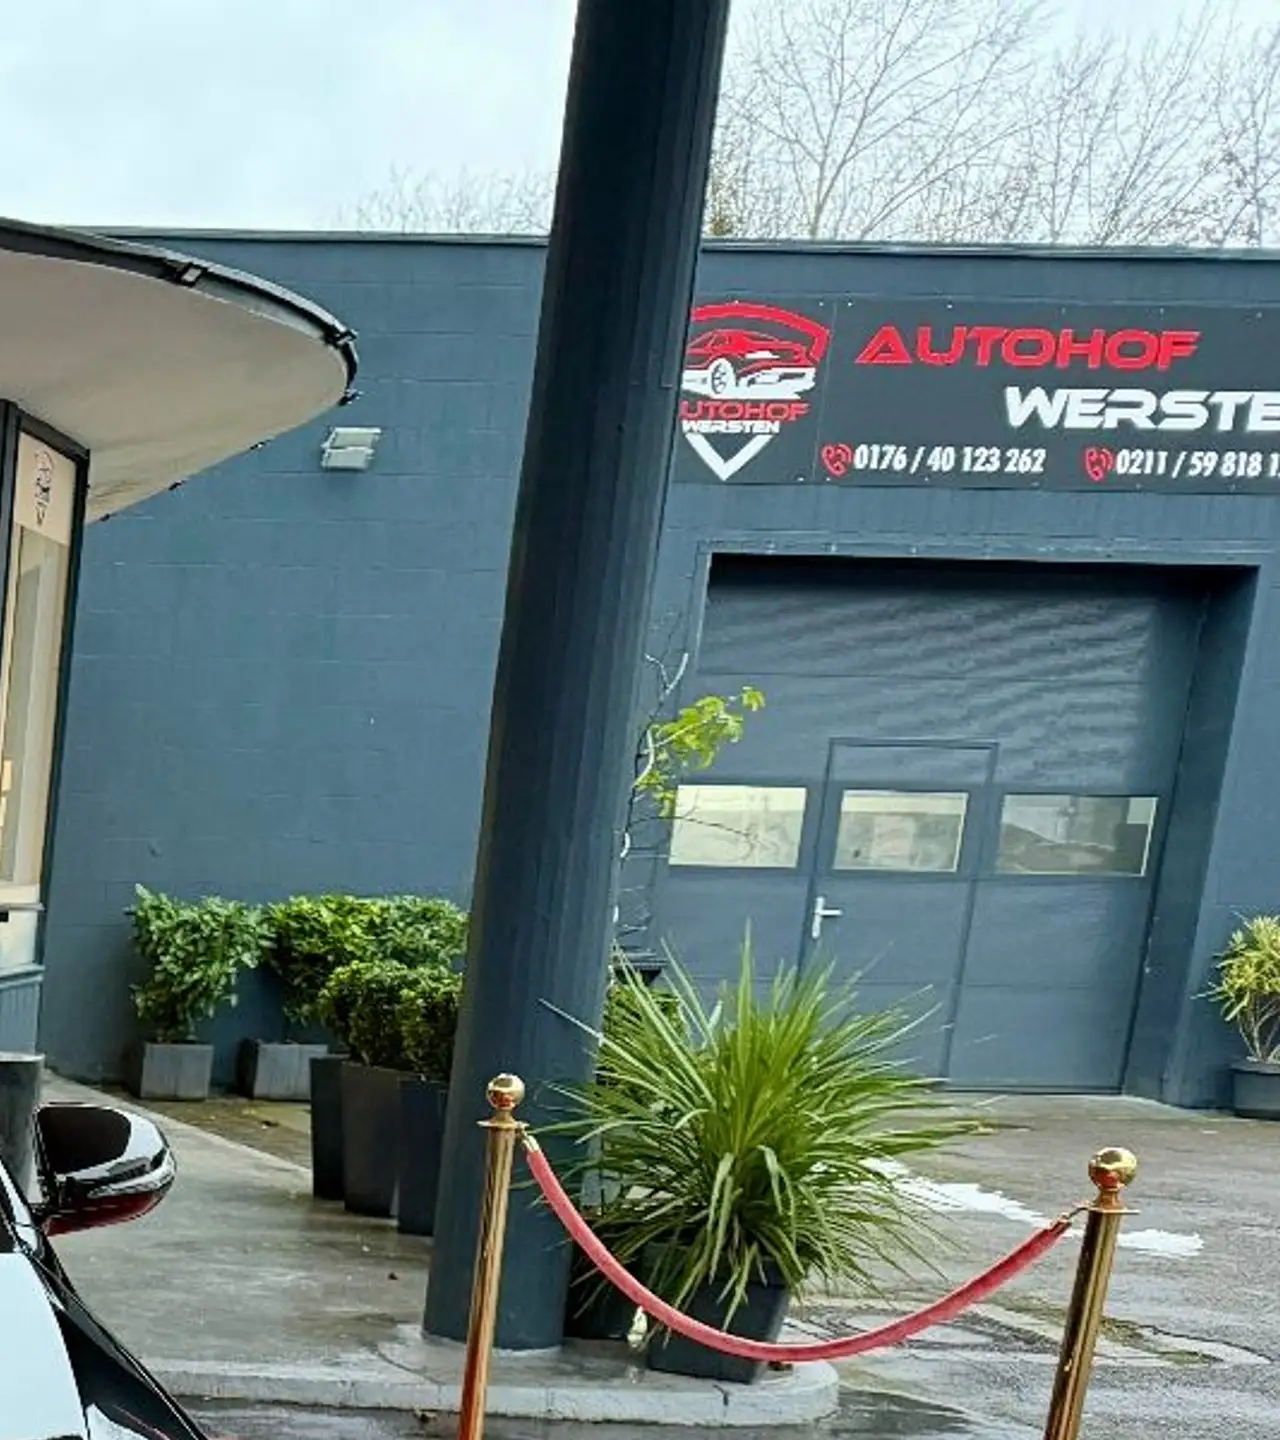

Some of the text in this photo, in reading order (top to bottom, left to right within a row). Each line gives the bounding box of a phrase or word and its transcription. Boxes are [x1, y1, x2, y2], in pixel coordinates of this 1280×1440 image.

[854, 325, 1203, 372] AUTOHOF
[681, 419, 780, 434] WERSTEN
[853, 444, 907, 471] 0176
[927, 446, 956, 472] 40
[960, 446, 1001, 472] 123
[1004, 448, 1047, 473] 262
[1115, 449, 1169, 475] 0211
[1190, 451, 1218, 477] 59
[1220, 451, 1263, 478] 818
